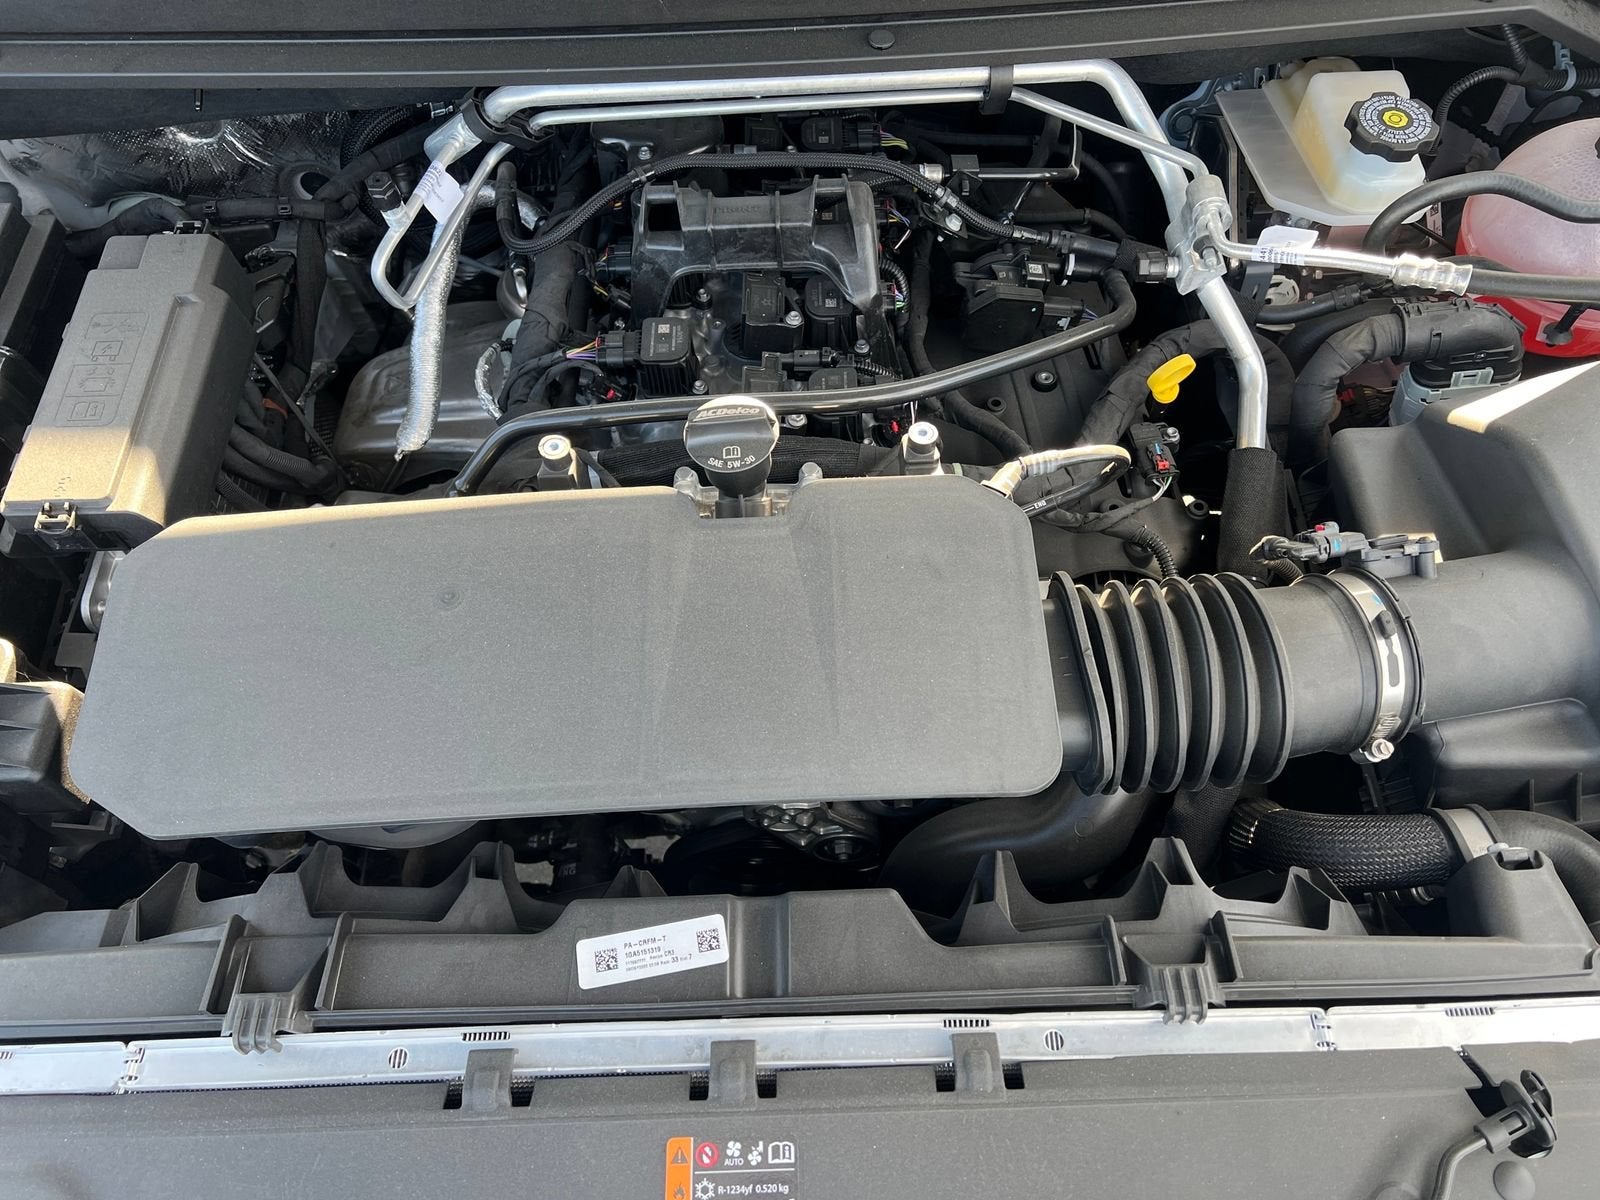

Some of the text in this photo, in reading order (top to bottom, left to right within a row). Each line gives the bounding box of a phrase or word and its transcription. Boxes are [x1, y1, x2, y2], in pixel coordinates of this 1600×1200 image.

[696, 407, 760, 418] ACDelco
[707, 454, 756, 469] SAE 5W-30
[718, 1183, 789, 1195] R-1234yf 0.520 kg
